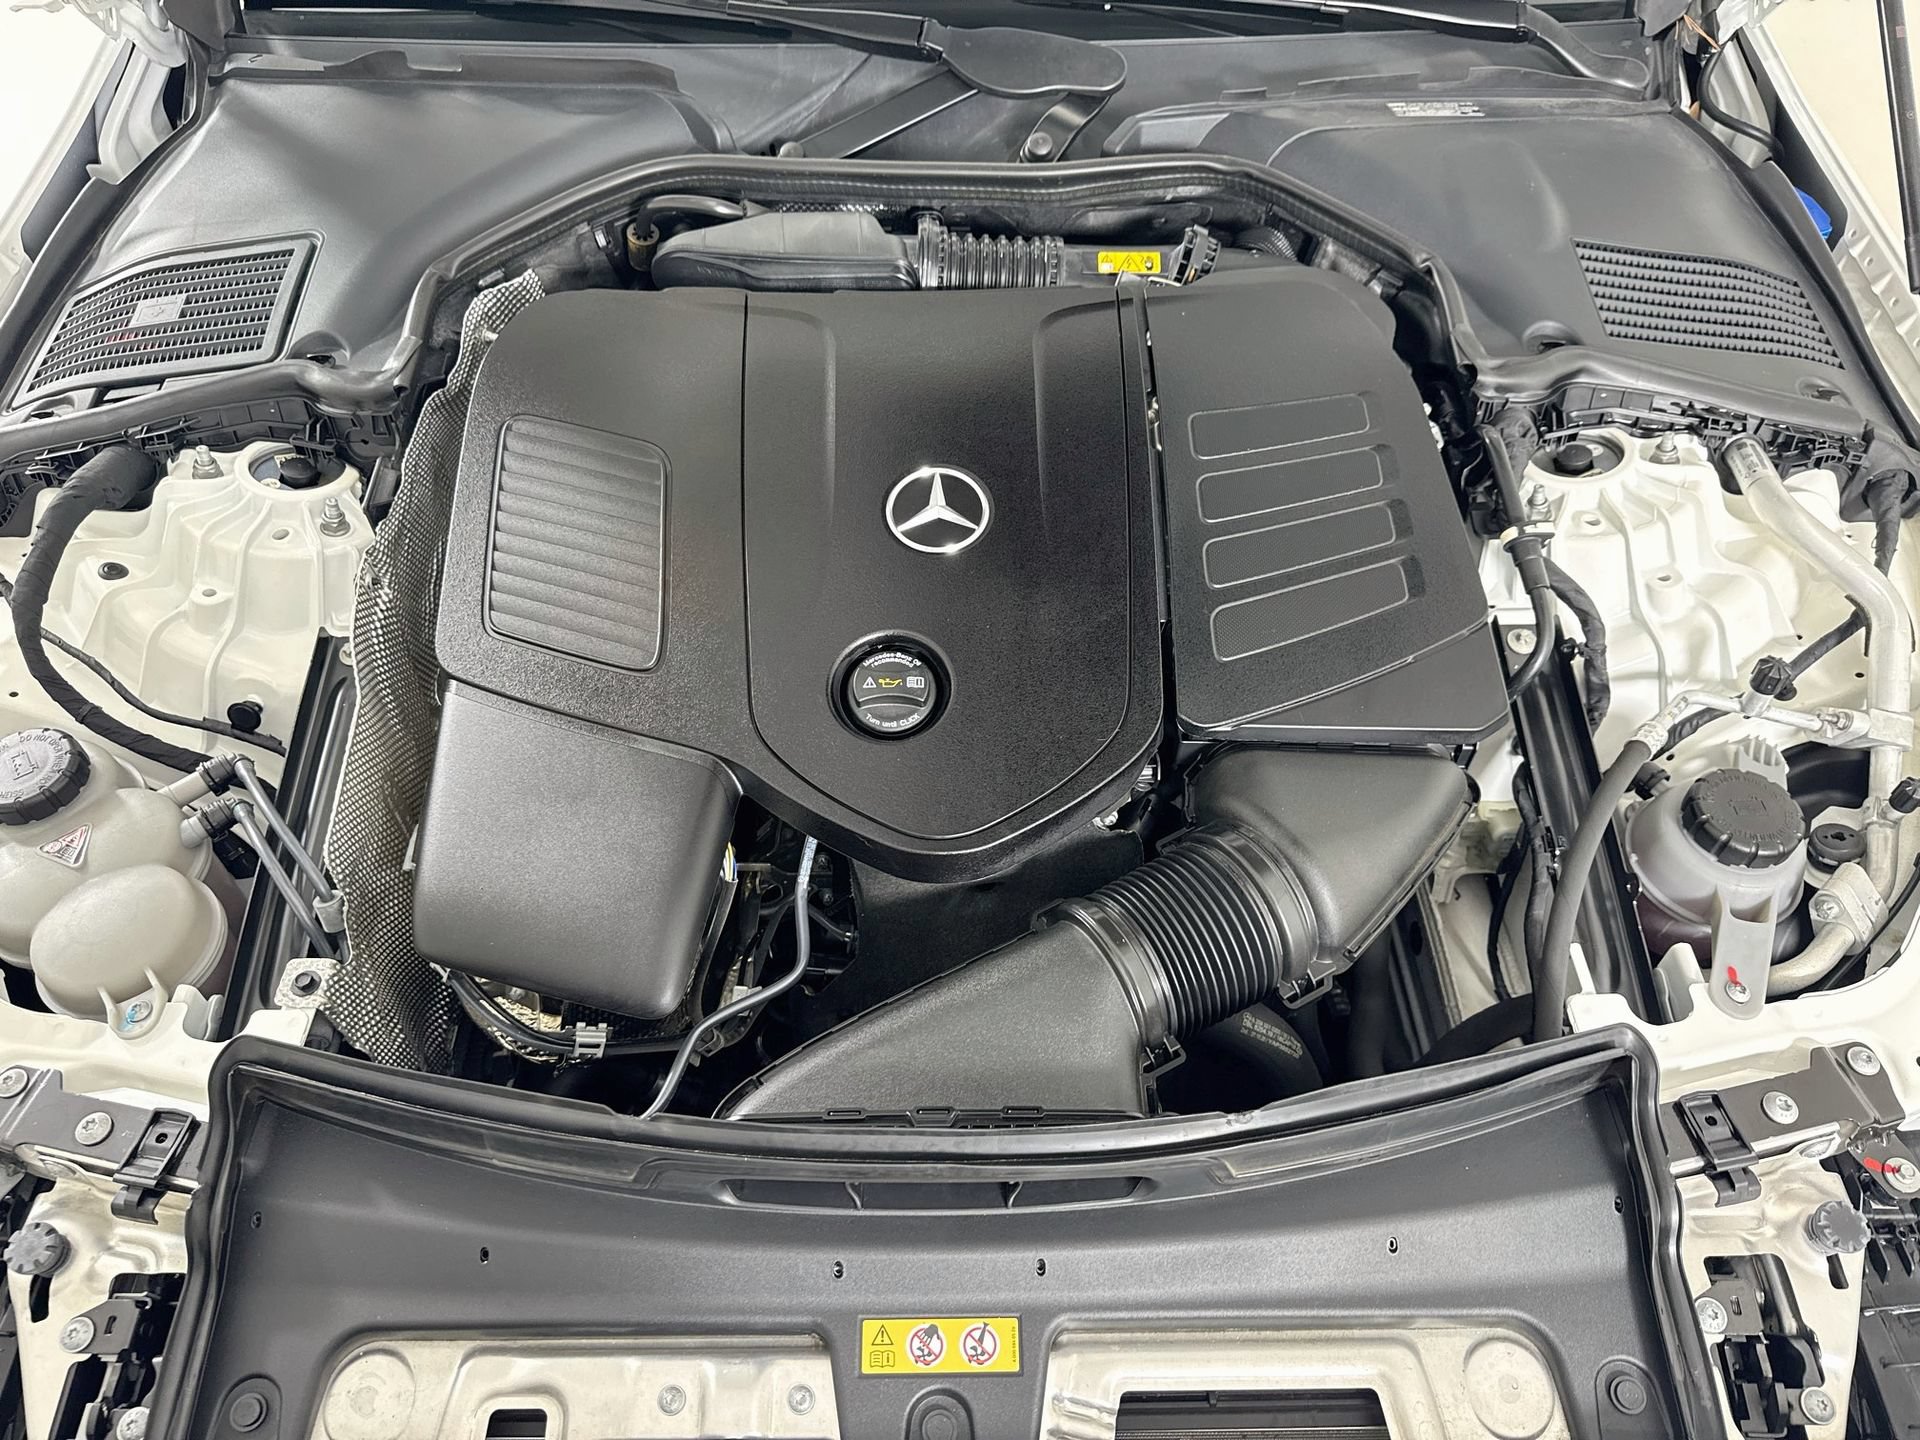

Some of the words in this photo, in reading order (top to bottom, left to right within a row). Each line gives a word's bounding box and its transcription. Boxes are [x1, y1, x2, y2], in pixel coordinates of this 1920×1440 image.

[866, 713, 880, 726] Turn
[882, 720, 897, 728] until
[899, 713, 920, 726] CLICK
